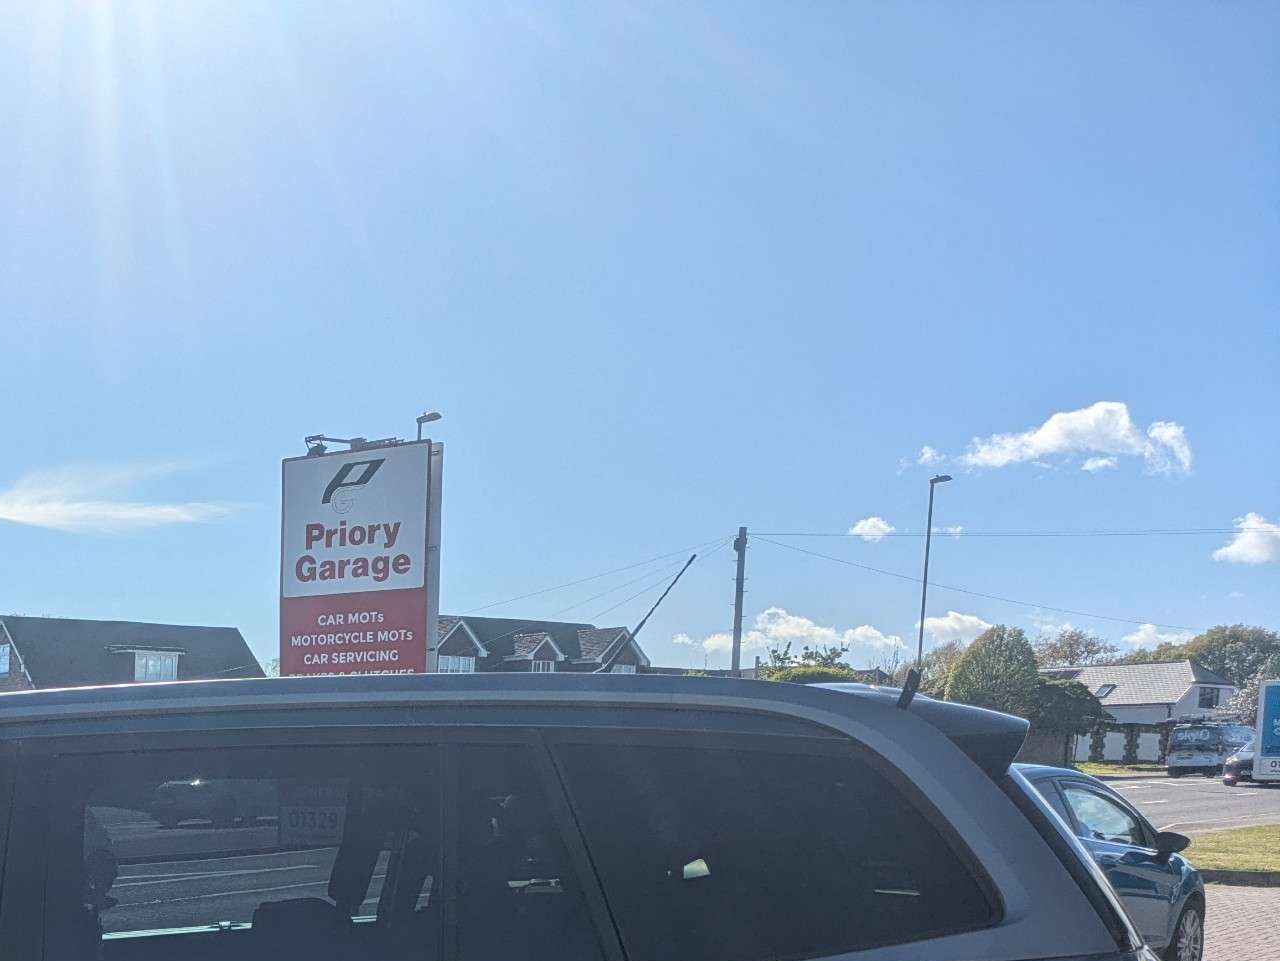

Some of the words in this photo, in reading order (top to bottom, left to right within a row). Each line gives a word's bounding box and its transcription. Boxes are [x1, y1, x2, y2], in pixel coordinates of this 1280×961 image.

[305, 520, 401, 550] Priory
[295, 553, 411, 583] Garage
[318, 614, 344, 626] CAR
[348, 611, 384, 623] MOTs
[291, 631, 374, 647] MOTORCYCLE
[378, 629, 413, 642] MOTs
[304, 654, 328, 665] CAR
[332, 650, 399, 664] SERVICING
